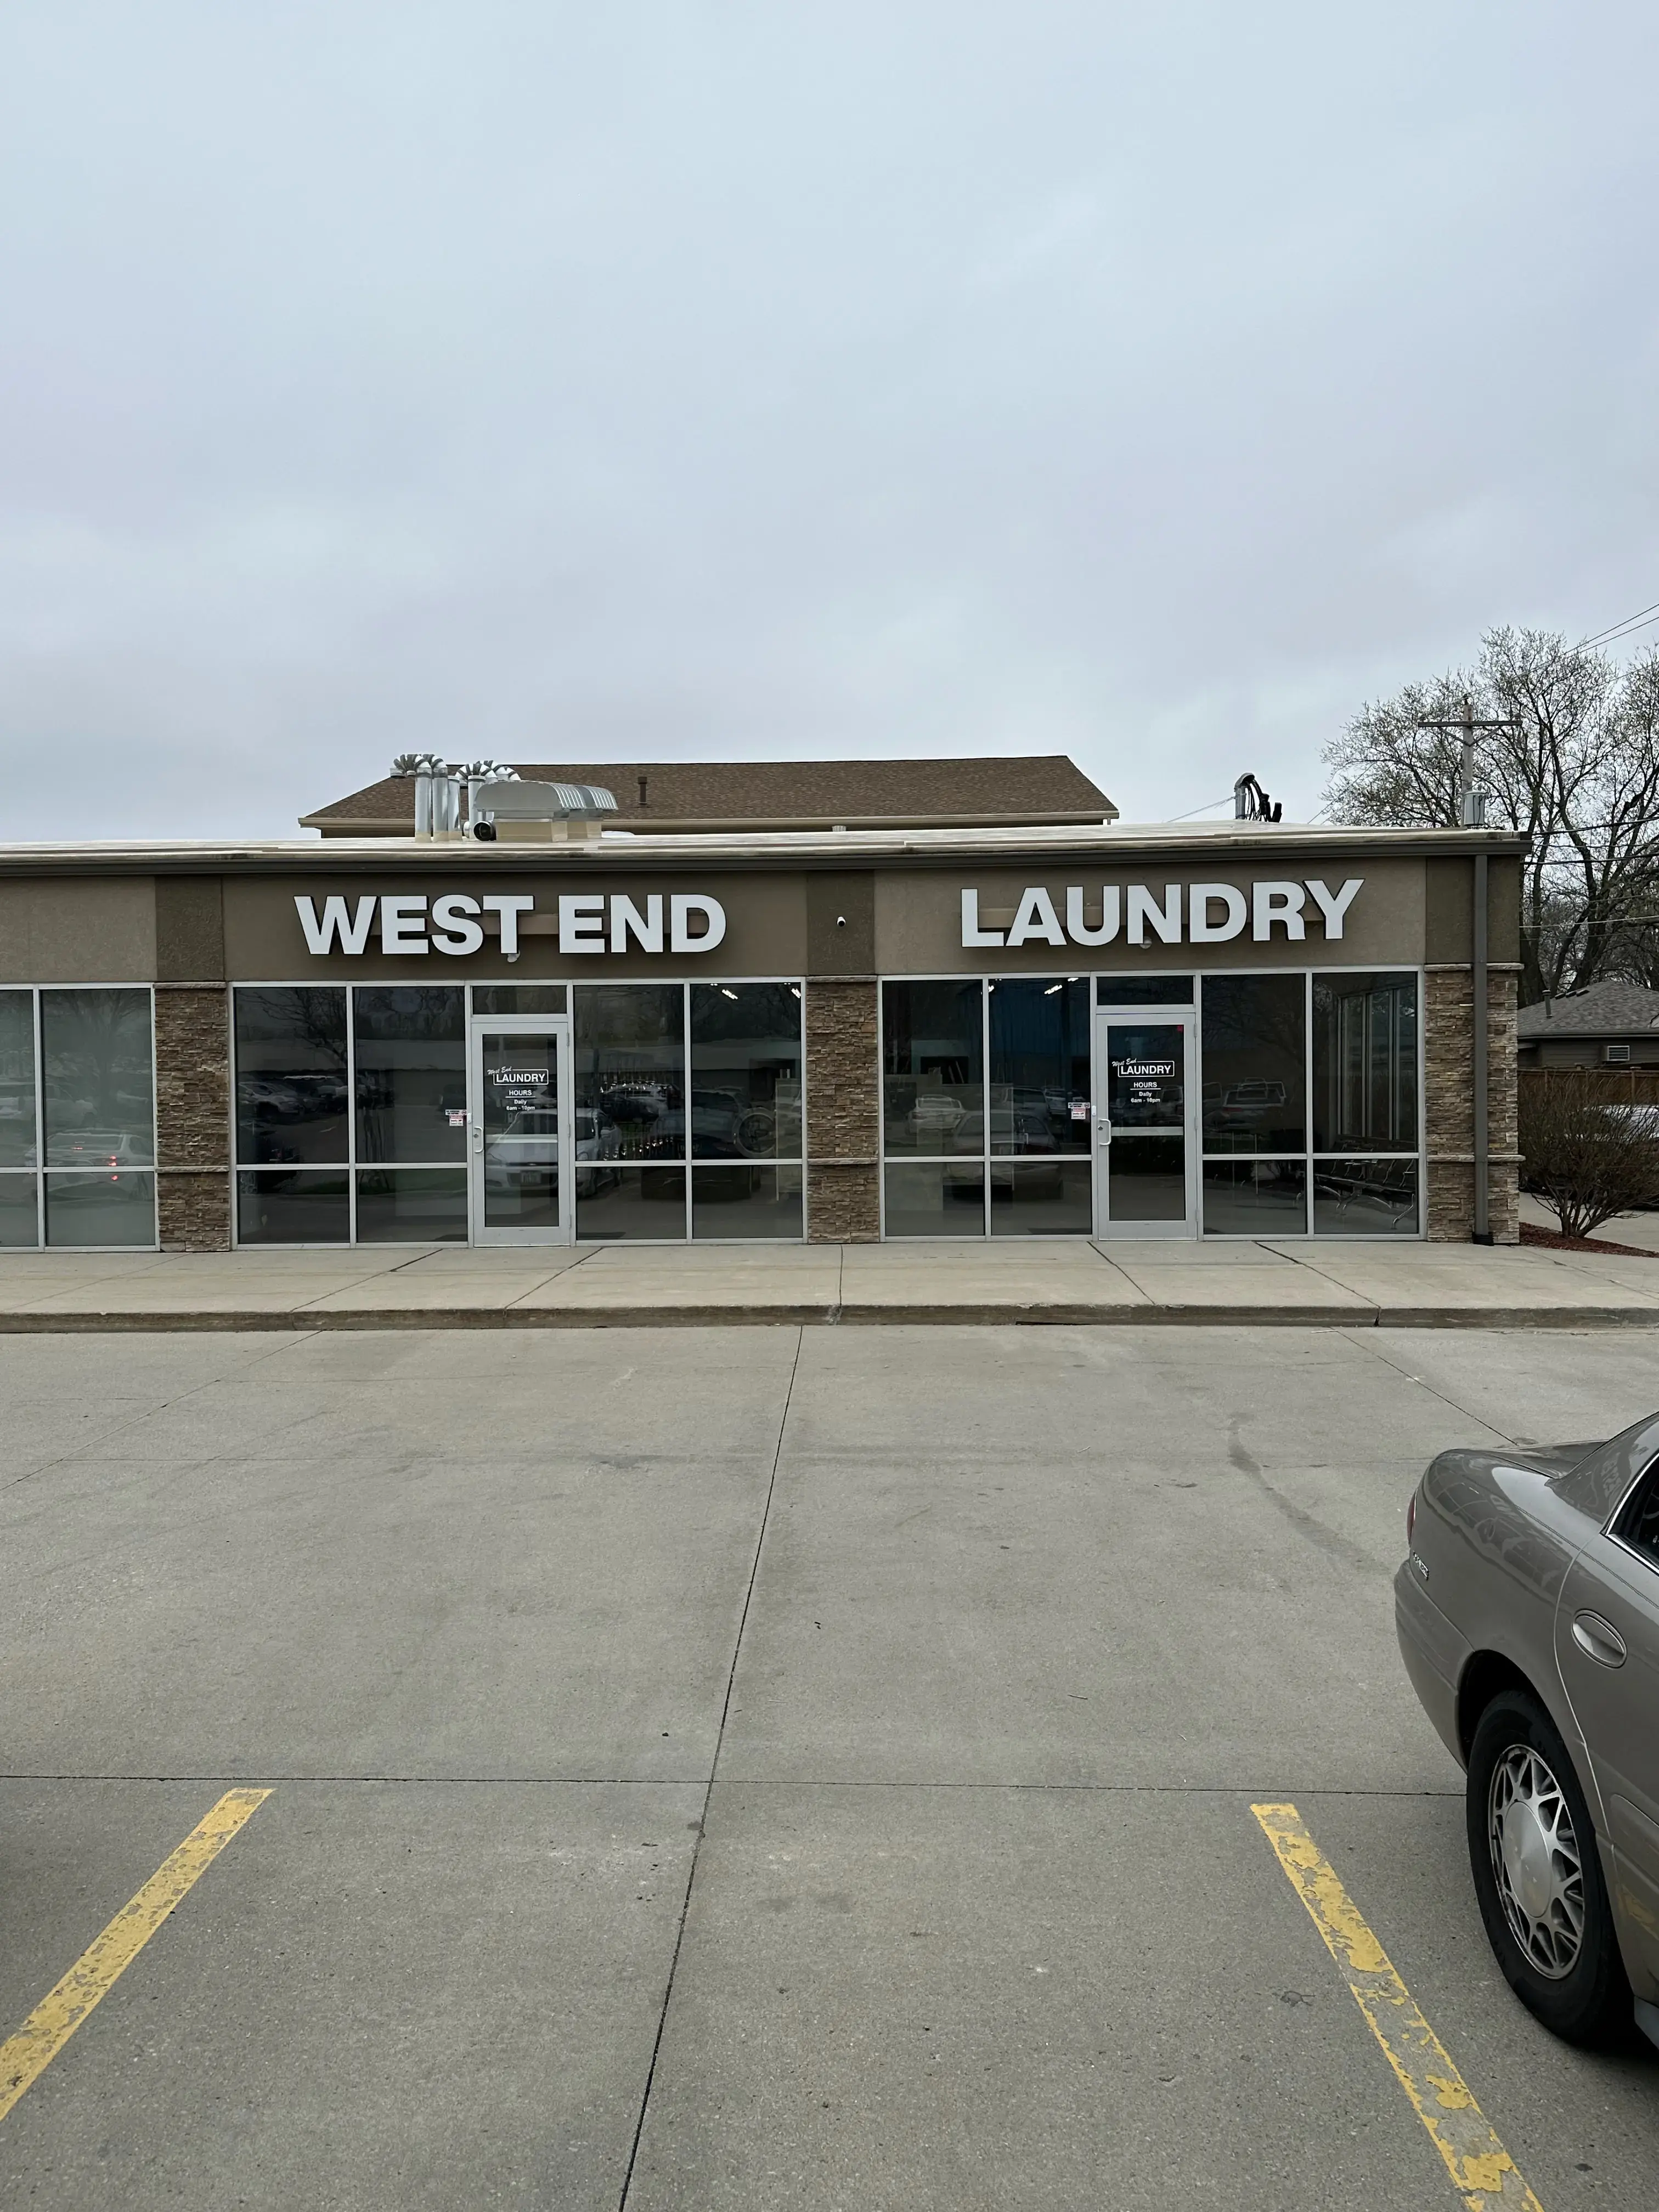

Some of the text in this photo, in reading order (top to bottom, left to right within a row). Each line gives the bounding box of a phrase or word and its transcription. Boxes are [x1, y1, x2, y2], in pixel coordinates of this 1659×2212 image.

[294, 878, 1365, 956] WEST END LAUNDRY
[1121, 1065, 1171, 1074] LAUNDRY
[496, 1073, 545, 1082] LAUNDRY
